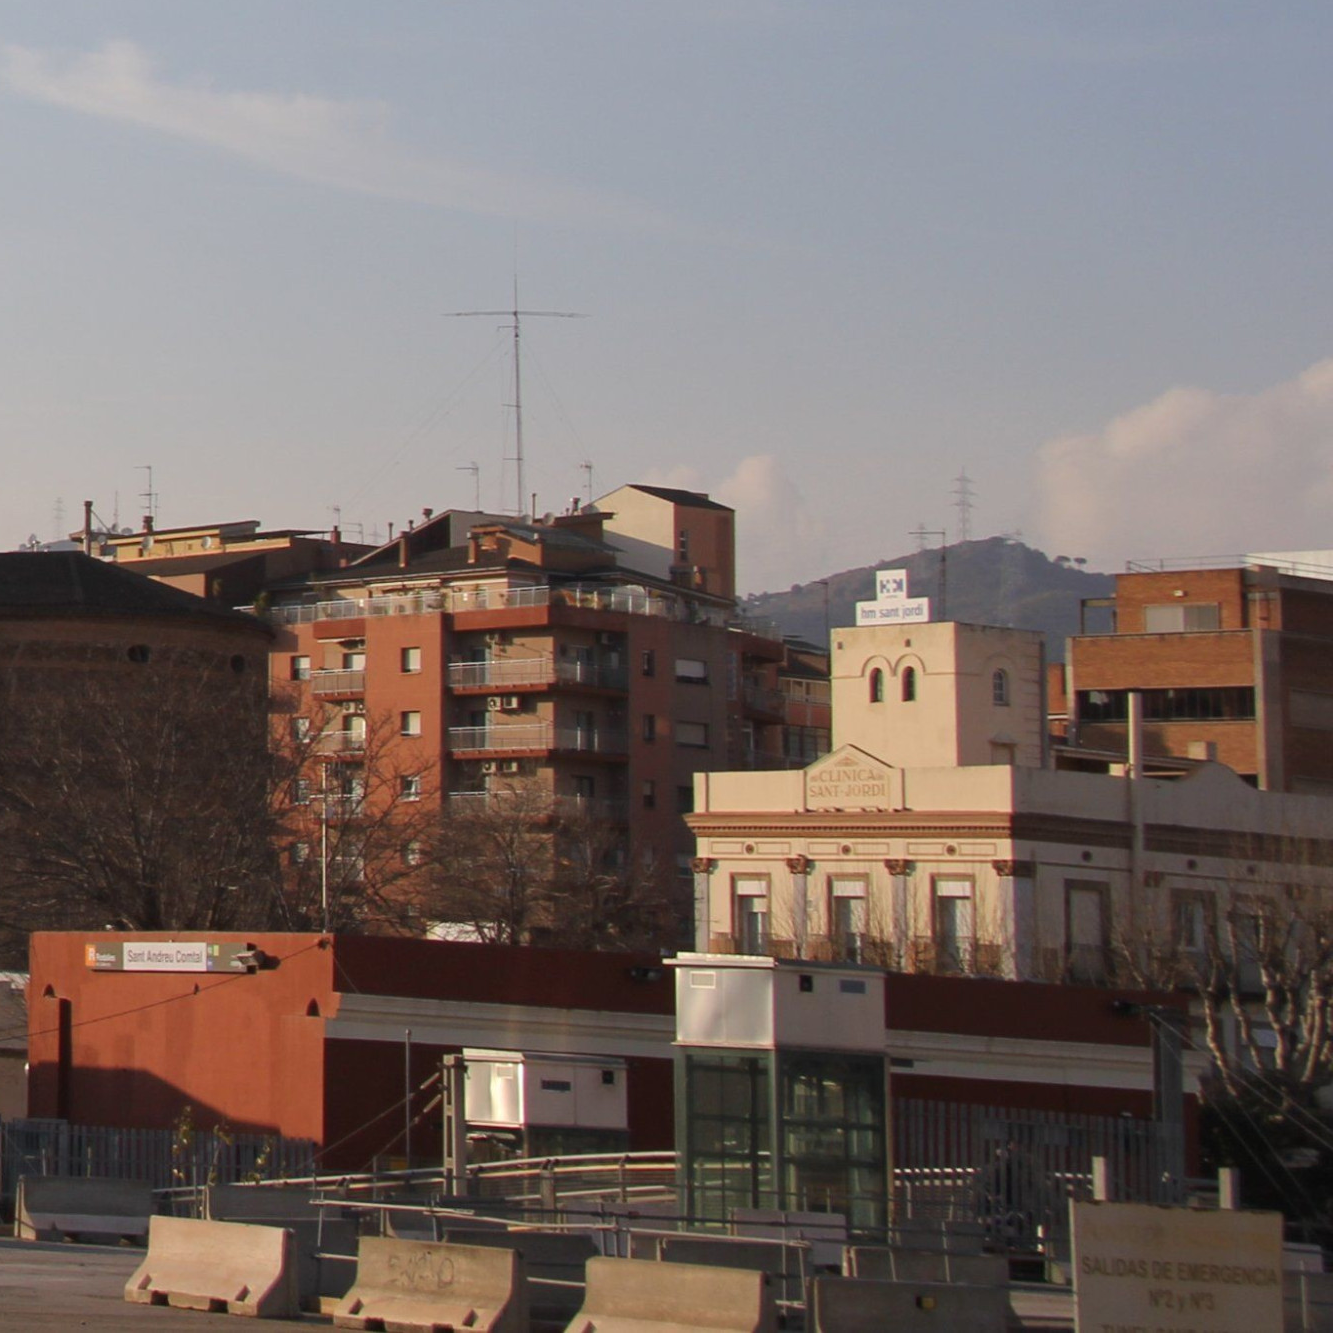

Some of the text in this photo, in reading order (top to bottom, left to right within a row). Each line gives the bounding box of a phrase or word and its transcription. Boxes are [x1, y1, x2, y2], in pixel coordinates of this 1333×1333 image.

[861, 603, 923, 619] hm sant jordi
[819, 769, 876, 782] CLINICA
[127, 950, 203, 964] Sant Andreu Comtal
[1083, 1256, 1278, 1286] SALIDAS DE EMERGENCIA
